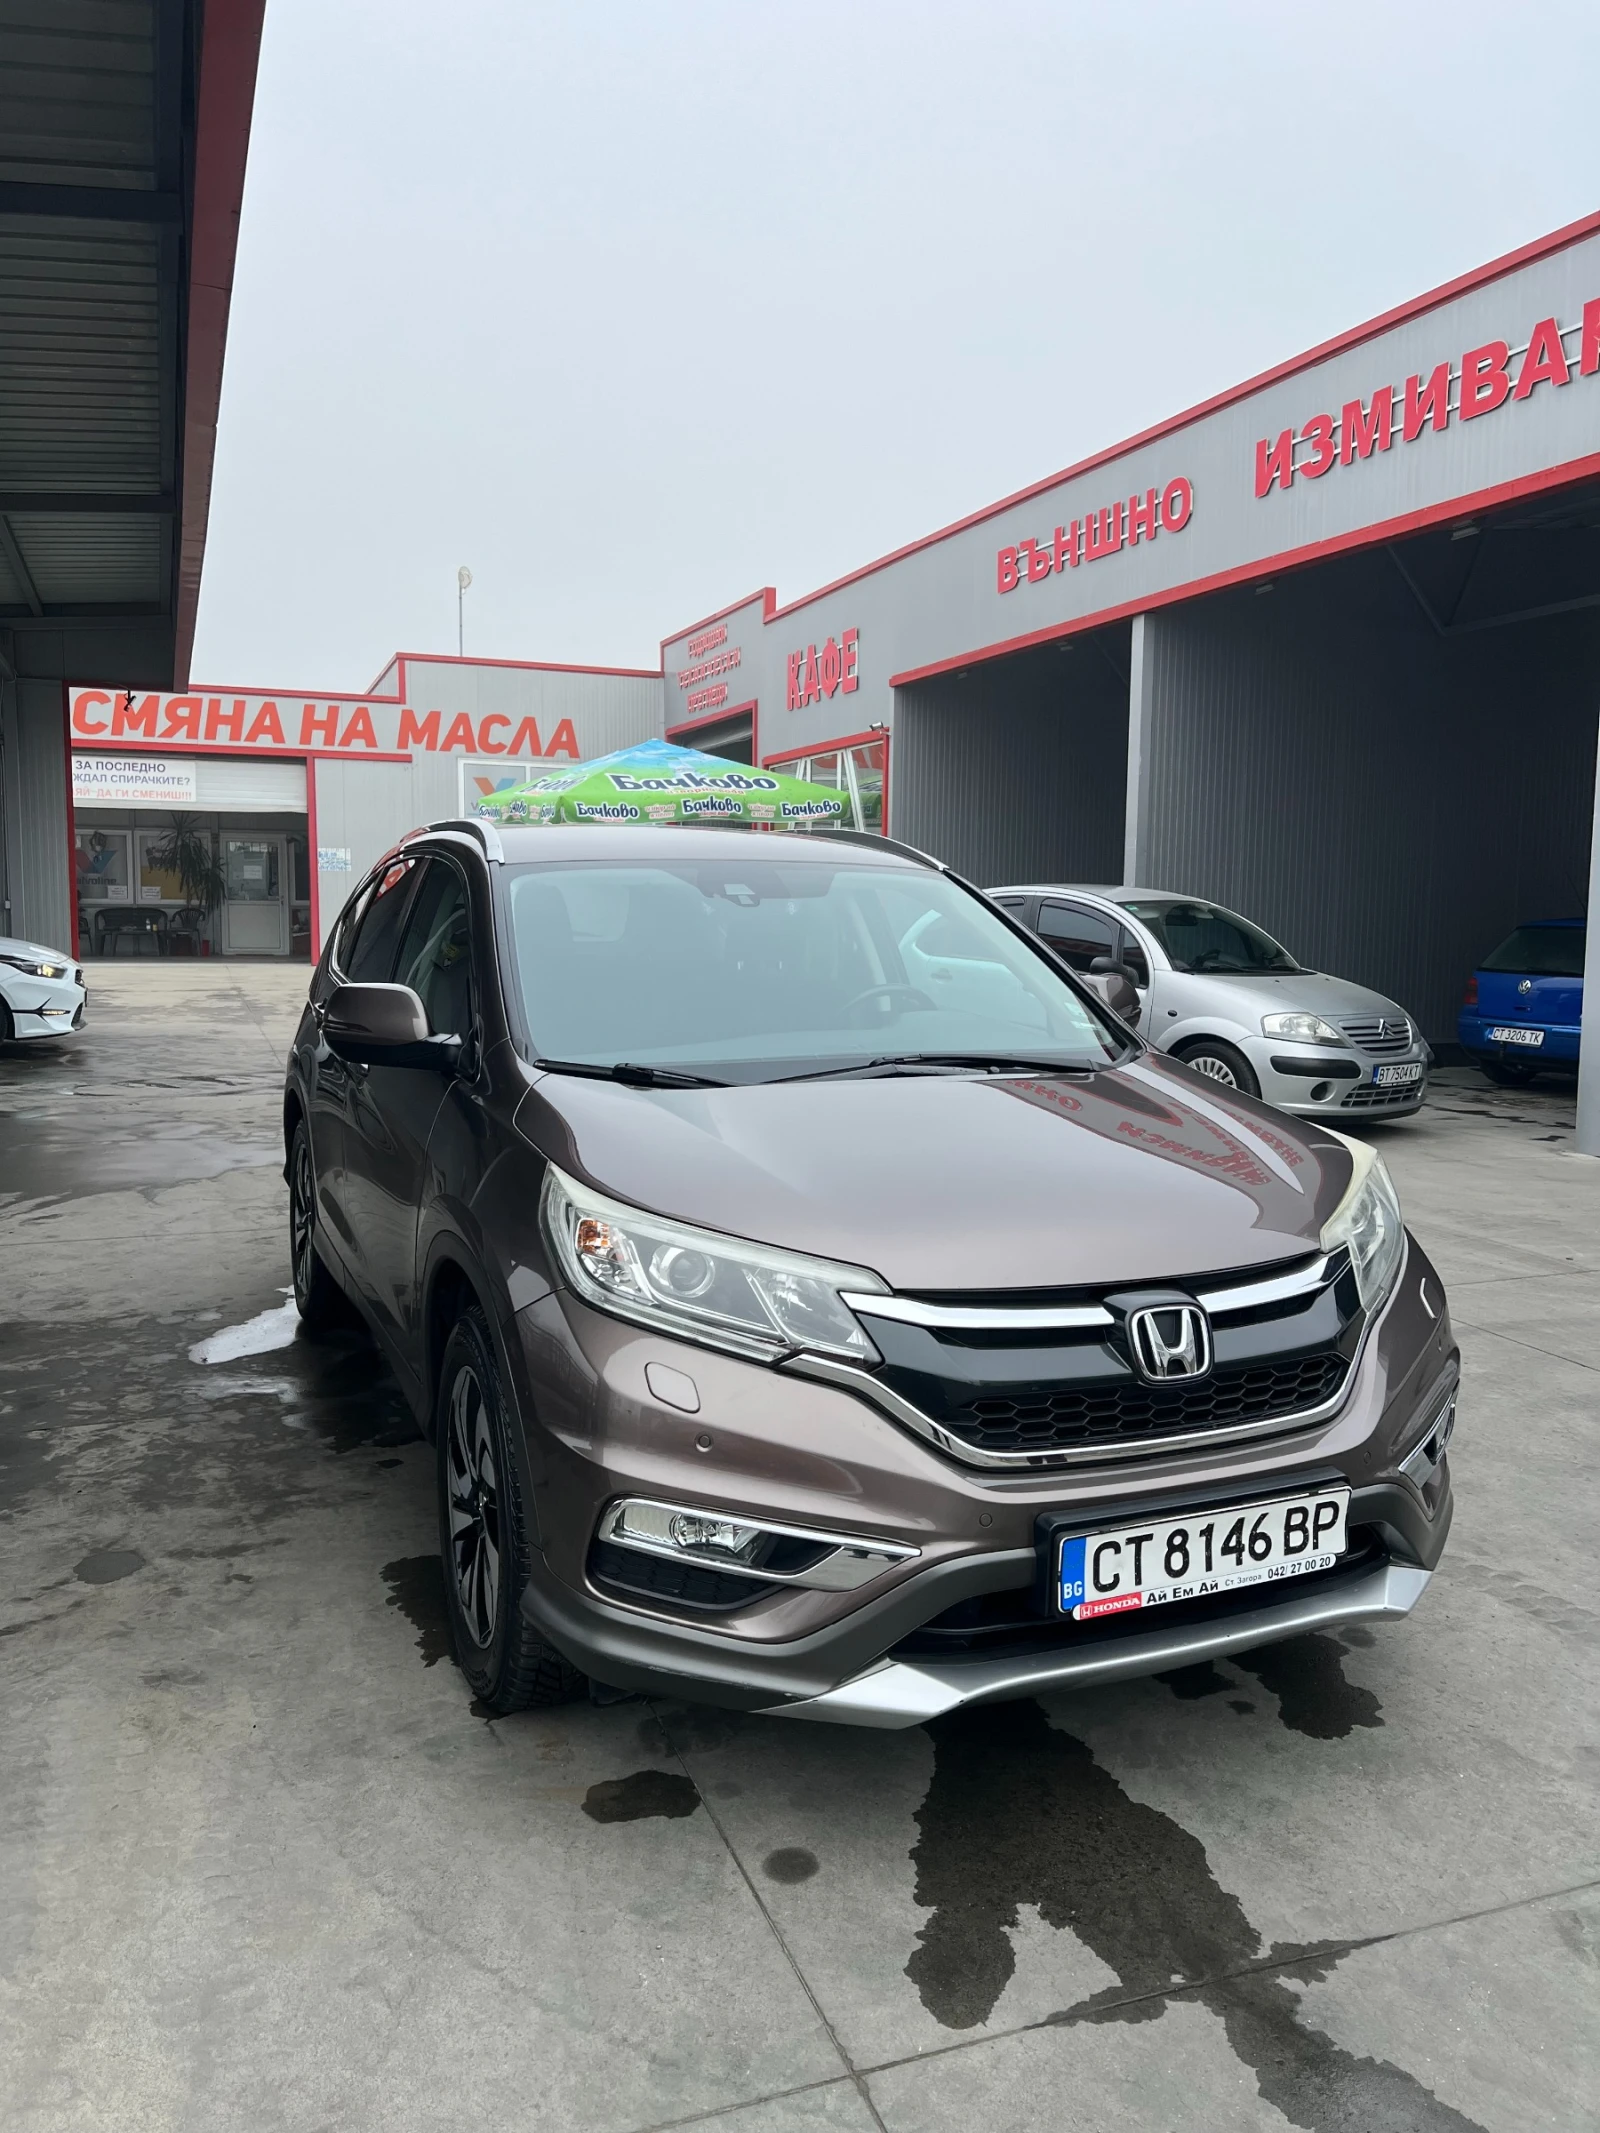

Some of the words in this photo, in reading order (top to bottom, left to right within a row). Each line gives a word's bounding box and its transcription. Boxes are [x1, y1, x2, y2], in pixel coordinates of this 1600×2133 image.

[997, 476, 1193, 594] ВЪНШНО
[786, 627, 858, 711] КАФЕ
[72, 690, 286, 744] СМЯНА
[299, 704, 378, 748] НА
[397, 709, 581, 759] МАСЛА
[75, 760, 92, 770] ЗА
[96, 761, 166, 773] ПОСЛЕДНО
[110, 774, 191, 786] СПИРАЧКИТЕ?
[608, 772, 777, 790] Бачково
[115, 789, 129, 798] ГИ
[576, 802, 638, 818] Бачково
[682, 795, 741, 813] Бачково
[781, 800, 841, 816] Бачково
[1146, 1590, 1167, 1604] Ай
[1173, 1587, 1193, 1599] Ем
[1199, 1579, 1219, 1593] Ай
[1237, 1574, 1262, 1585] Загора
[1291, 1562, 1302, 1574] 27
[1305, 1559, 1317, 1571] 00
[1320, 1556, 1331, 1568] 20
[1063, 1580, 1083, 1599] BG
[1093, 1596, 1141, 1614] HONDA
